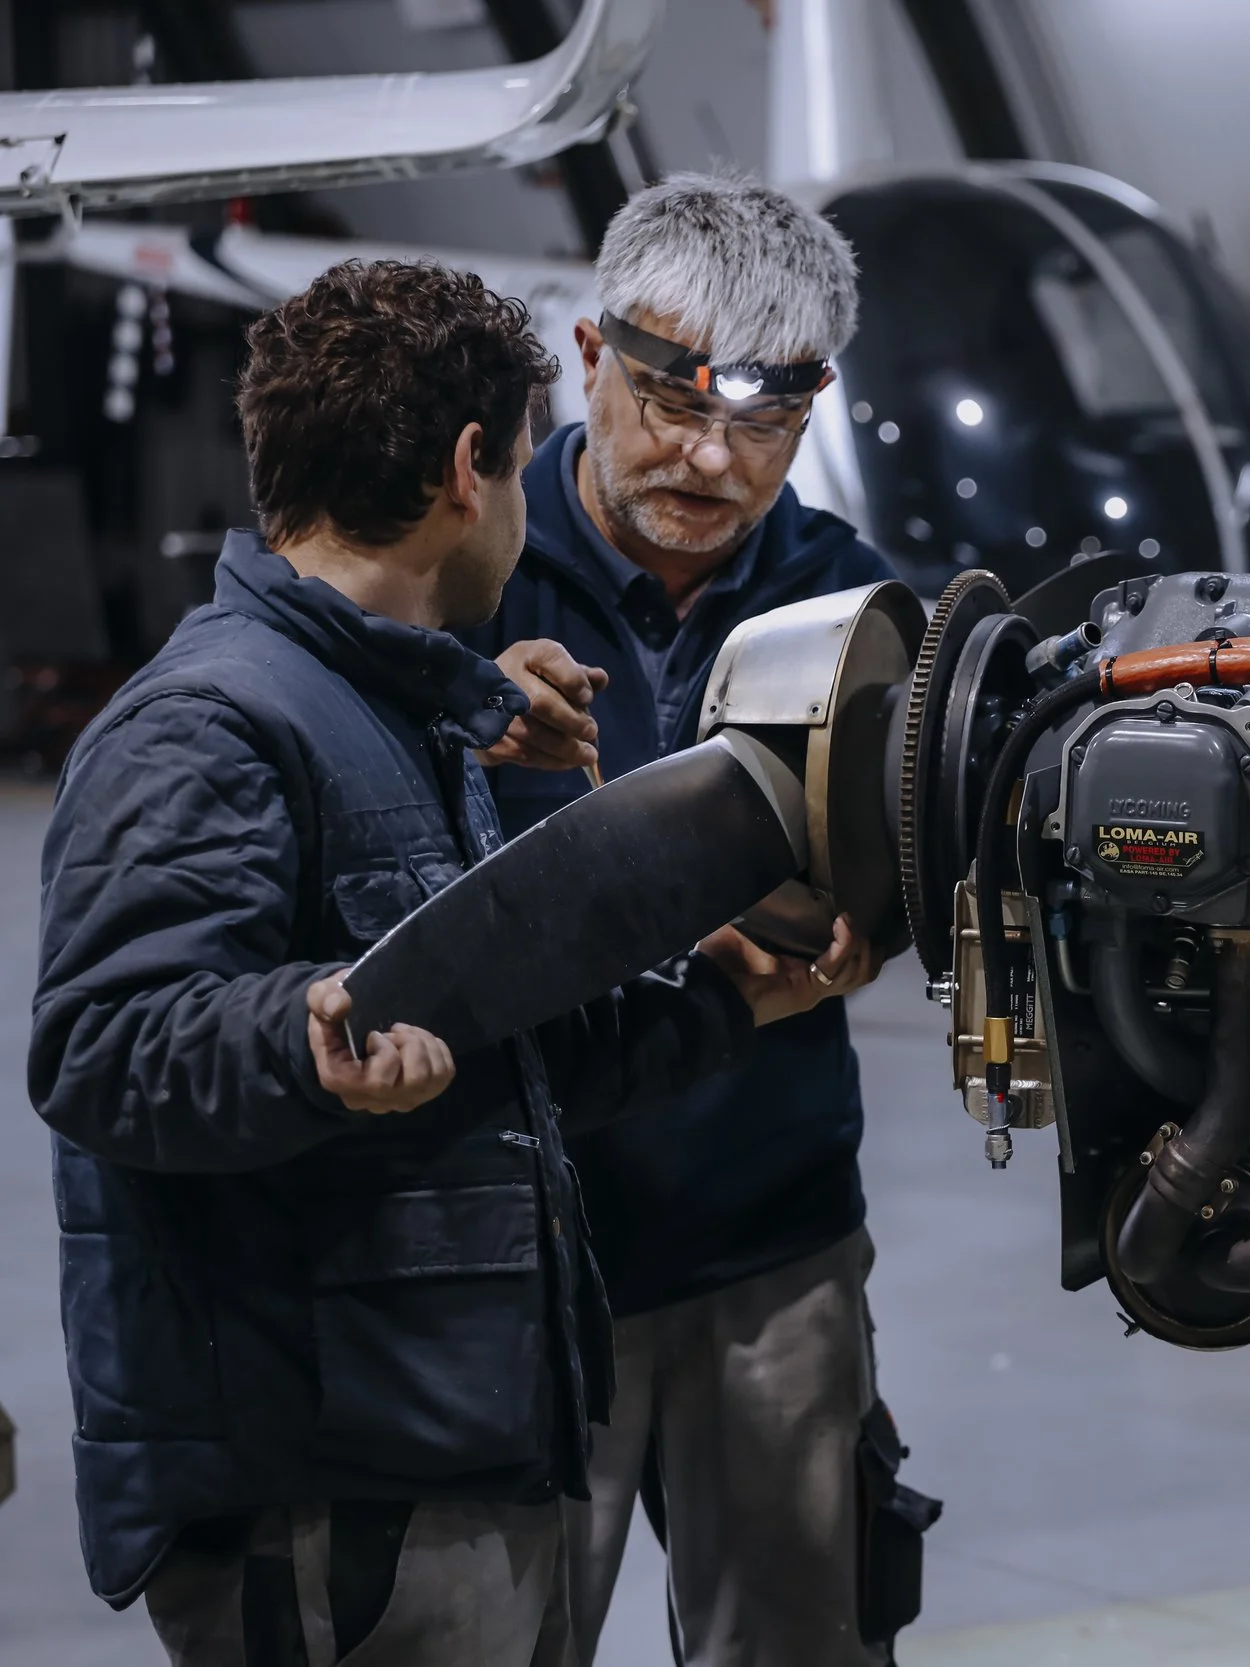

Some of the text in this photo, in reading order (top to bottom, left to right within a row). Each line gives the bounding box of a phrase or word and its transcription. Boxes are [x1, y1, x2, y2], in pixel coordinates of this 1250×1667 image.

[1108, 798, 1192, 819] LYCOMING
[1099, 826, 1198, 845] LOMA-AIR
[1122, 845, 1180, 857] POWERED BY
[1130, 855, 1174, 864] LOMA-AIR
[1121, 864, 1180, 873] info@loma-air.com
[1026, 993, 1034, 1030] MEGGITT
